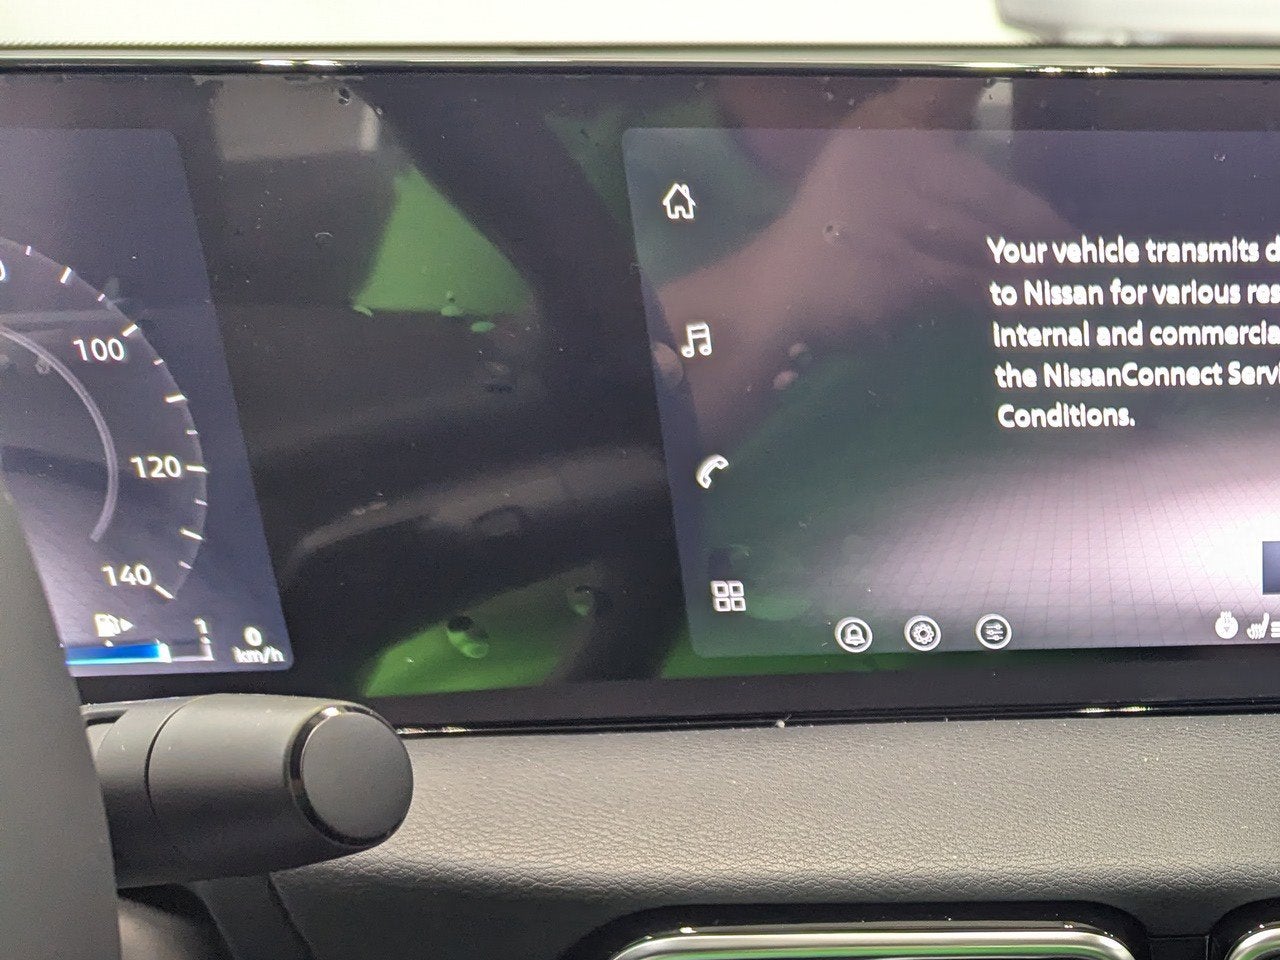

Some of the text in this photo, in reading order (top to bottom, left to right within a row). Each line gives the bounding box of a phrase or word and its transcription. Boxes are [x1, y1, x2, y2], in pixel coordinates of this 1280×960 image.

[986, 235, 1048, 264] Your
[1052, 234, 1140, 264] vehicle
[1146, 235, 1260, 263] transmits
[990, 281, 1018, 305] to
[1023, 278, 1103, 305] Nissan
[1110, 277, 1148, 305] for
[1152, 278, 1241, 305] various
[992, 319, 1090, 347] internal
[1096, 318, 1143, 346] and
[73, 338, 125, 362] 100
[994, 362, 1037, 388] the
[1043, 361, 1223, 388] NissanConnect
[997, 402, 1136, 428] Conditions.
[131, 455, 181, 479] 120
[101, 564, 152, 587] 140
[244, 625, 262, 647] 0
[232, 646, 284, 664] km/h
